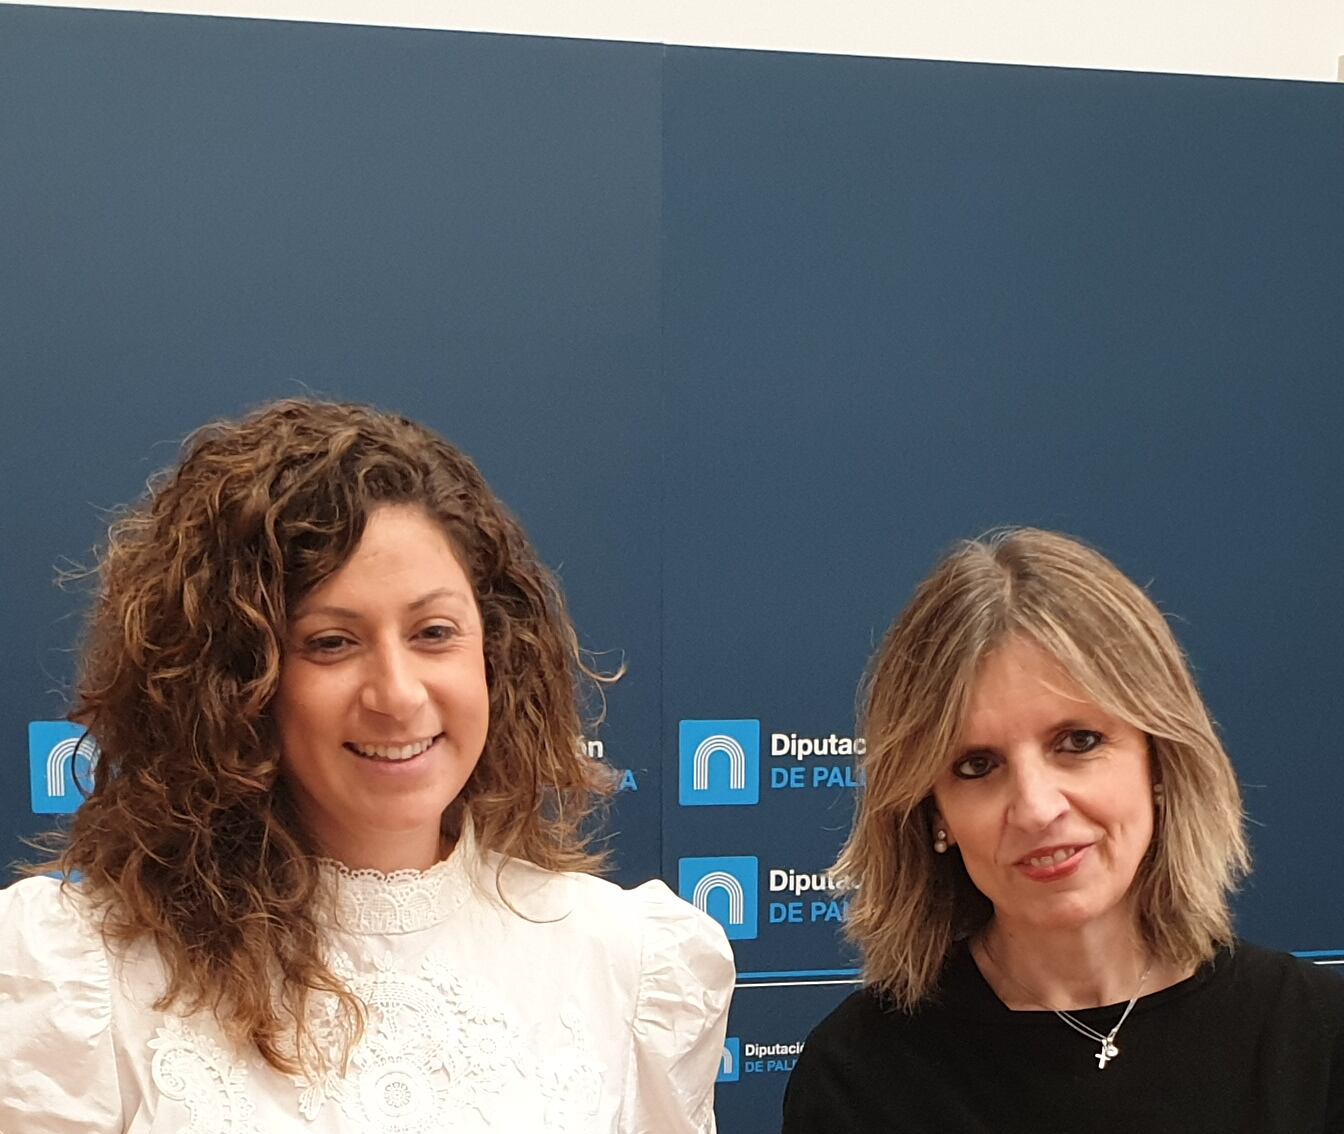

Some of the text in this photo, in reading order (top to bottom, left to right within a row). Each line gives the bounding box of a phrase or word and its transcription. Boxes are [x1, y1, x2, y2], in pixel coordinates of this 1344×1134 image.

[771, 734, 866, 760] Diputac
[771, 767, 806, 788] DE
[769, 902, 803, 923] DE
[745, 1060, 764, 1073] DE
